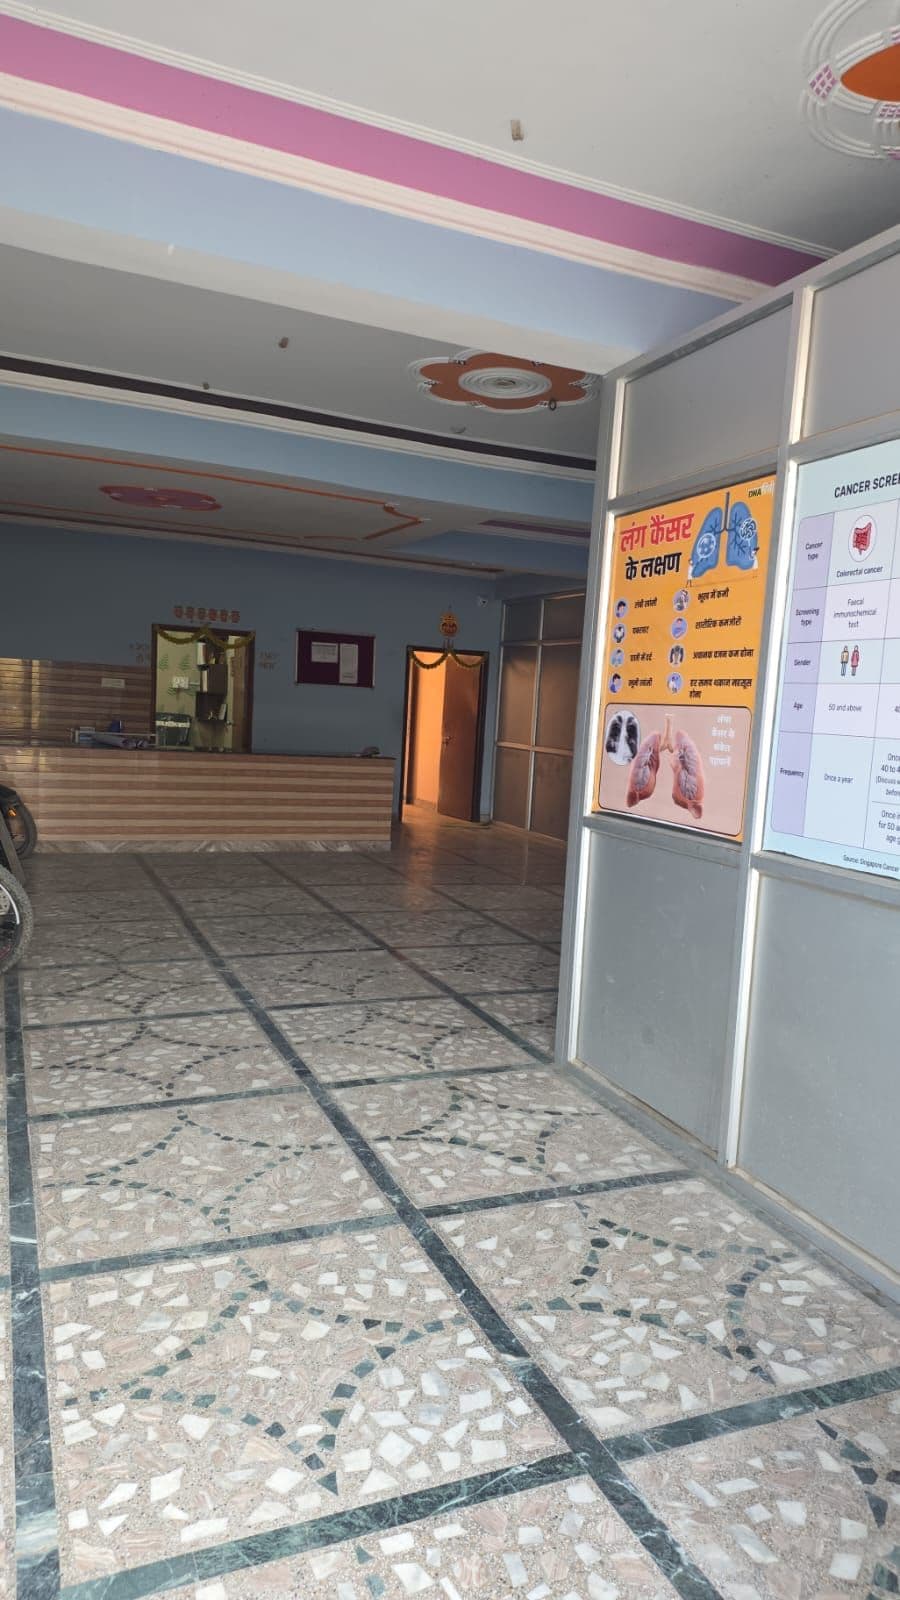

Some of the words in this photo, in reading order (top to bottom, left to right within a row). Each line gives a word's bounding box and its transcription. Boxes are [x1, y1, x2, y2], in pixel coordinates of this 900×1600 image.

[748, 487, 762, 498] DNA
[834, 479, 871, 498] CANCER
[620, 521, 648, 552] लंग
[650, 513, 695, 545] कैंसर
[805, 541, 823, 551] Cancer
[808, 553, 818, 561] type
[625, 556, 639, 580] के
[641, 552, 682, 578] लक्षण
[836, 568, 863, 578] Colorectal
[863, 566, 883, 576] cancer
[698, 592, 709, 603] भूख
[716, 587, 729, 598] कमी
[847, 598, 864, 607] Faecal
[795, 608, 820, 618] Screening
[833, 608, 876, 620] immunochemical
[695, 618, 717, 629] शारीरिक
[800, 618, 812, 628] type
[848, 620, 859, 629] test
[740, 647, 754, 657] होना
[690, 679, 698, 687] हर
[698, 679, 712, 687] समय
[731, 679, 752, 689] महसूस
[793, 702, 803, 712] Age
[828, 704, 836, 712] 50
[836, 704, 846, 712] and
[847, 704, 862, 712] above
[780, 768, 804, 779] Frequency
[881, 764, 888, 773] 40
[890, 765, 896, 773] to
[824, 773, 836, 783] Once
[841, 776, 854, 785] year
[881, 810, 896, 819] Once
[879, 820, 887, 829] for
[887, 822, 895, 831] 50
[886, 835, 896, 844] age
[859, 858, 882, 869] Singapore
